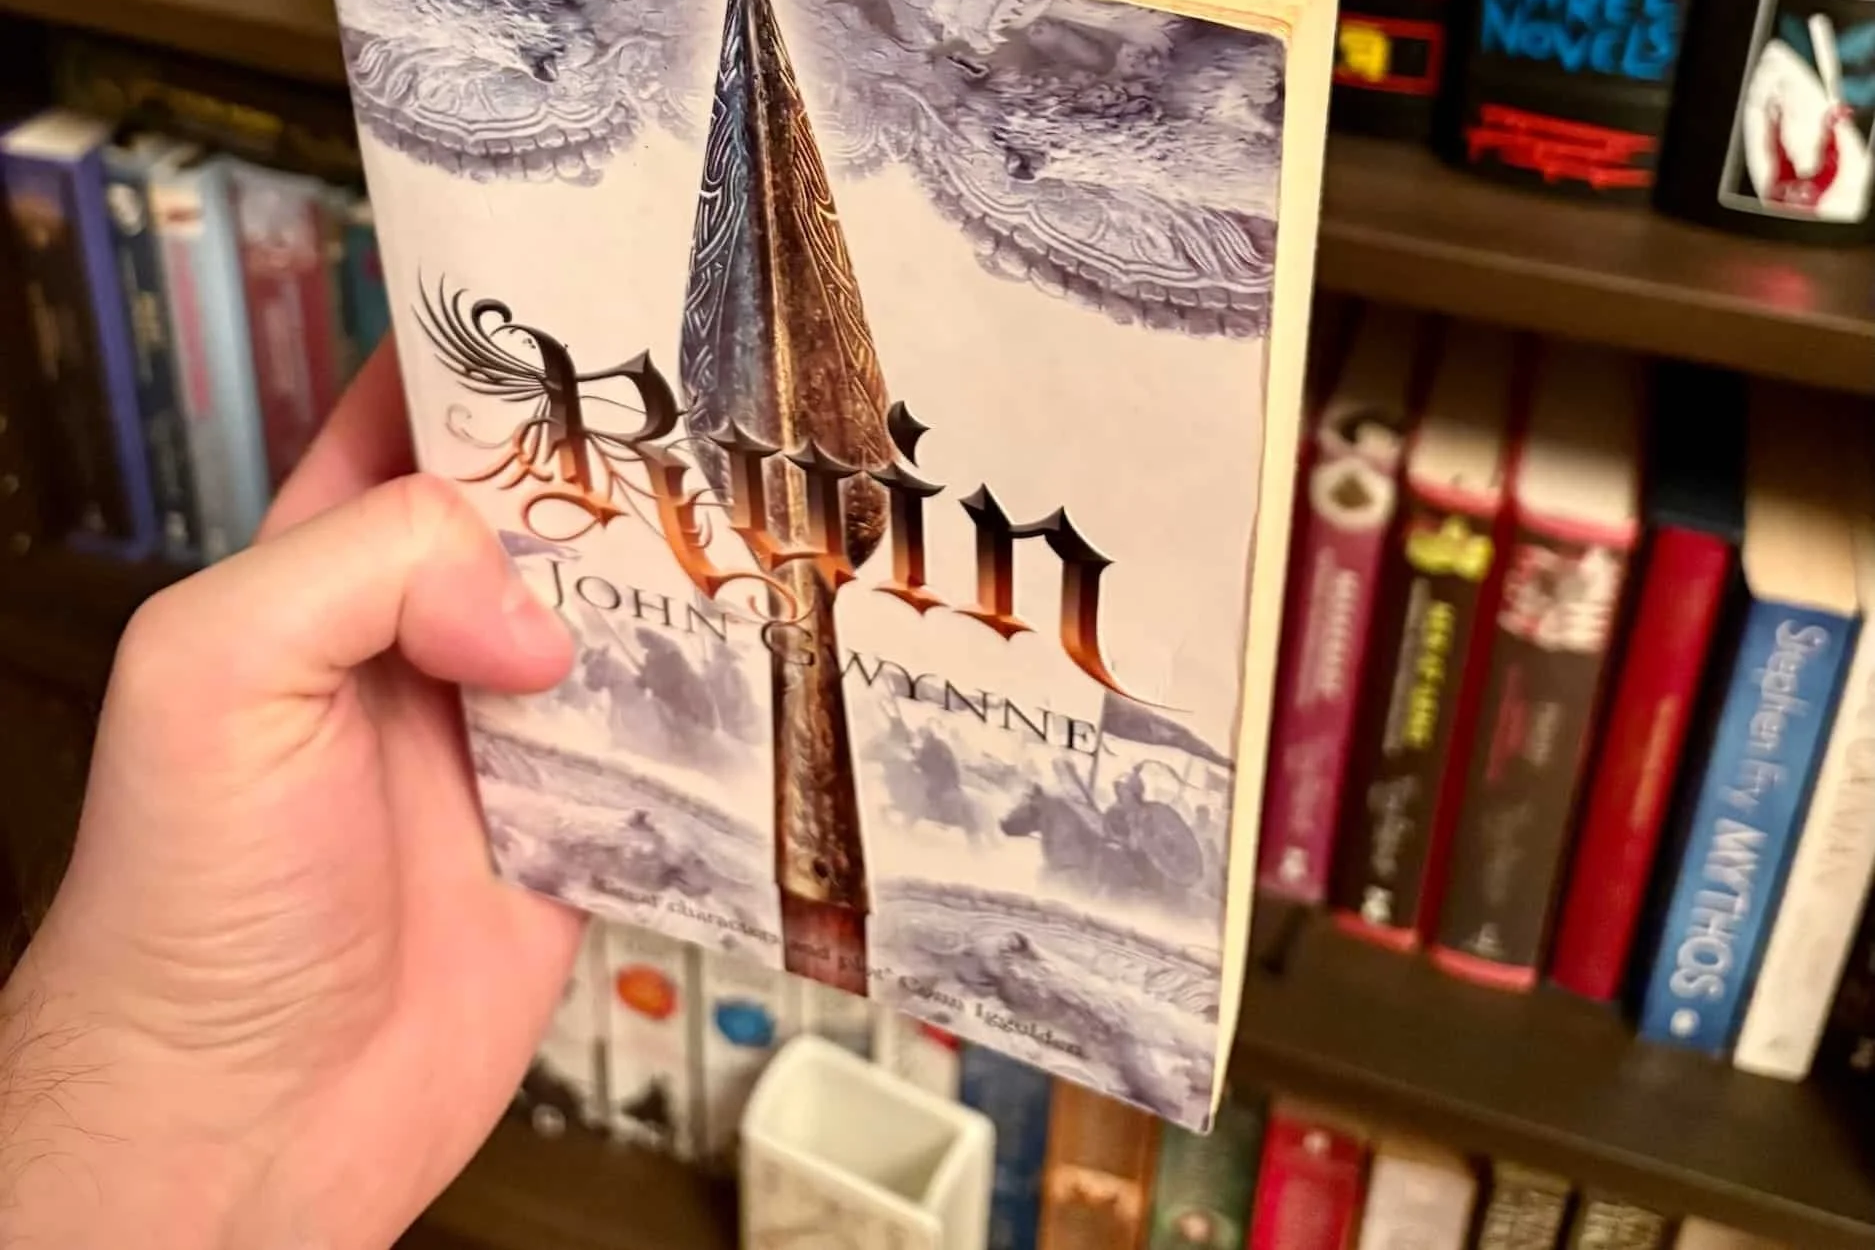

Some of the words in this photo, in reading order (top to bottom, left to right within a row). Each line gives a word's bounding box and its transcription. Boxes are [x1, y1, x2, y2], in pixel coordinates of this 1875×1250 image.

[411, 263, 1192, 713] Ruin
[547, 559, 728, 642] JOHN
[761, 620, 1117, 757] GWYNNE
[1751, 619, 1829, 751] Stephen
[1721, 759, 1788, 811] Fry
[1669, 817, 1767, 997] MYTHOS
